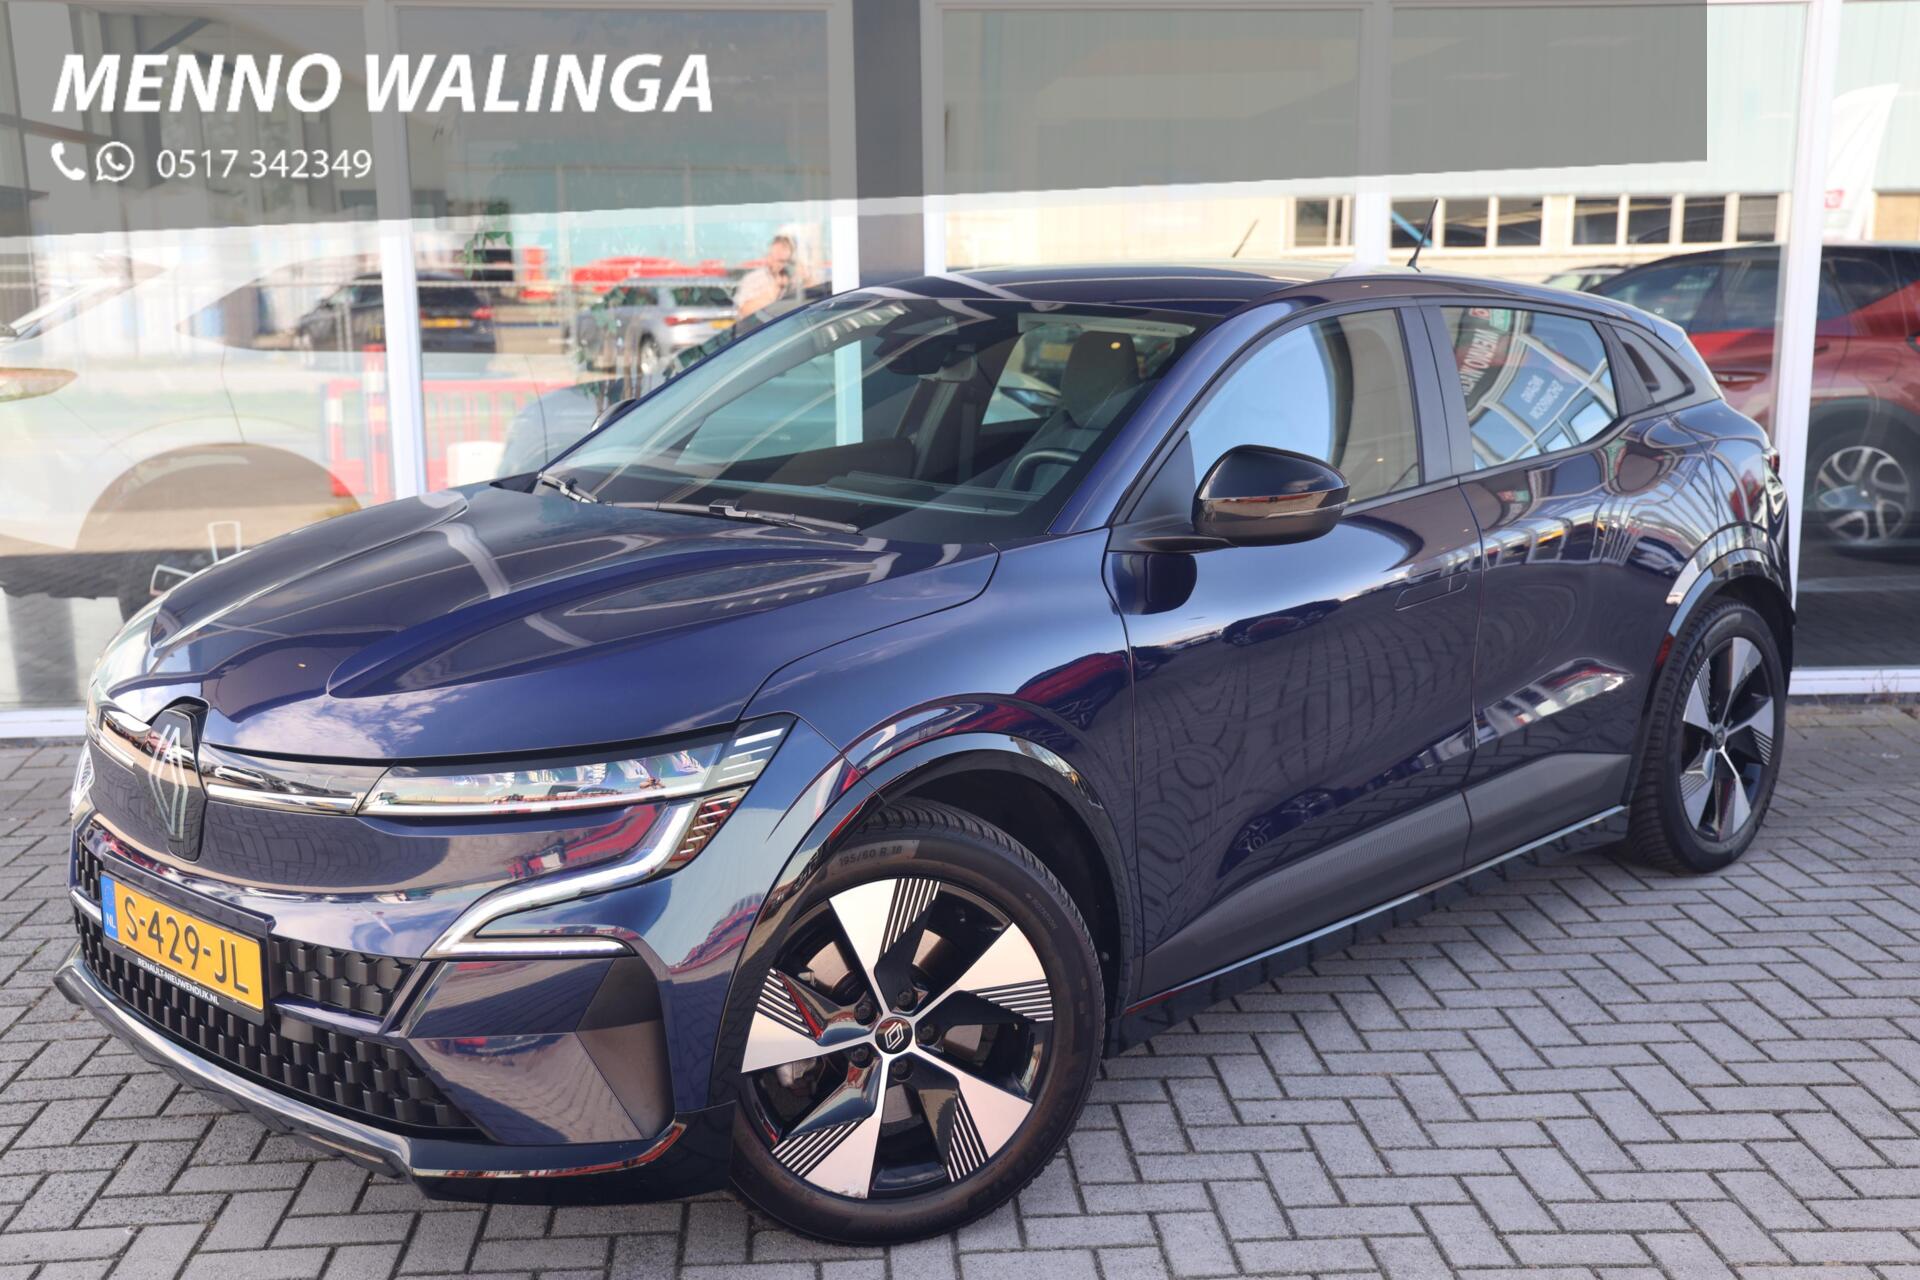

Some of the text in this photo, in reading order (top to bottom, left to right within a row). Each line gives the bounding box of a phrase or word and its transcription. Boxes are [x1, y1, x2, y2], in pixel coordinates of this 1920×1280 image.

[106, 912, 117, 930] NL
[125, 895, 249, 994] S-429-JL
[137, 957, 220, 1006] RENAULT-NIEUWENDIJK.NL
